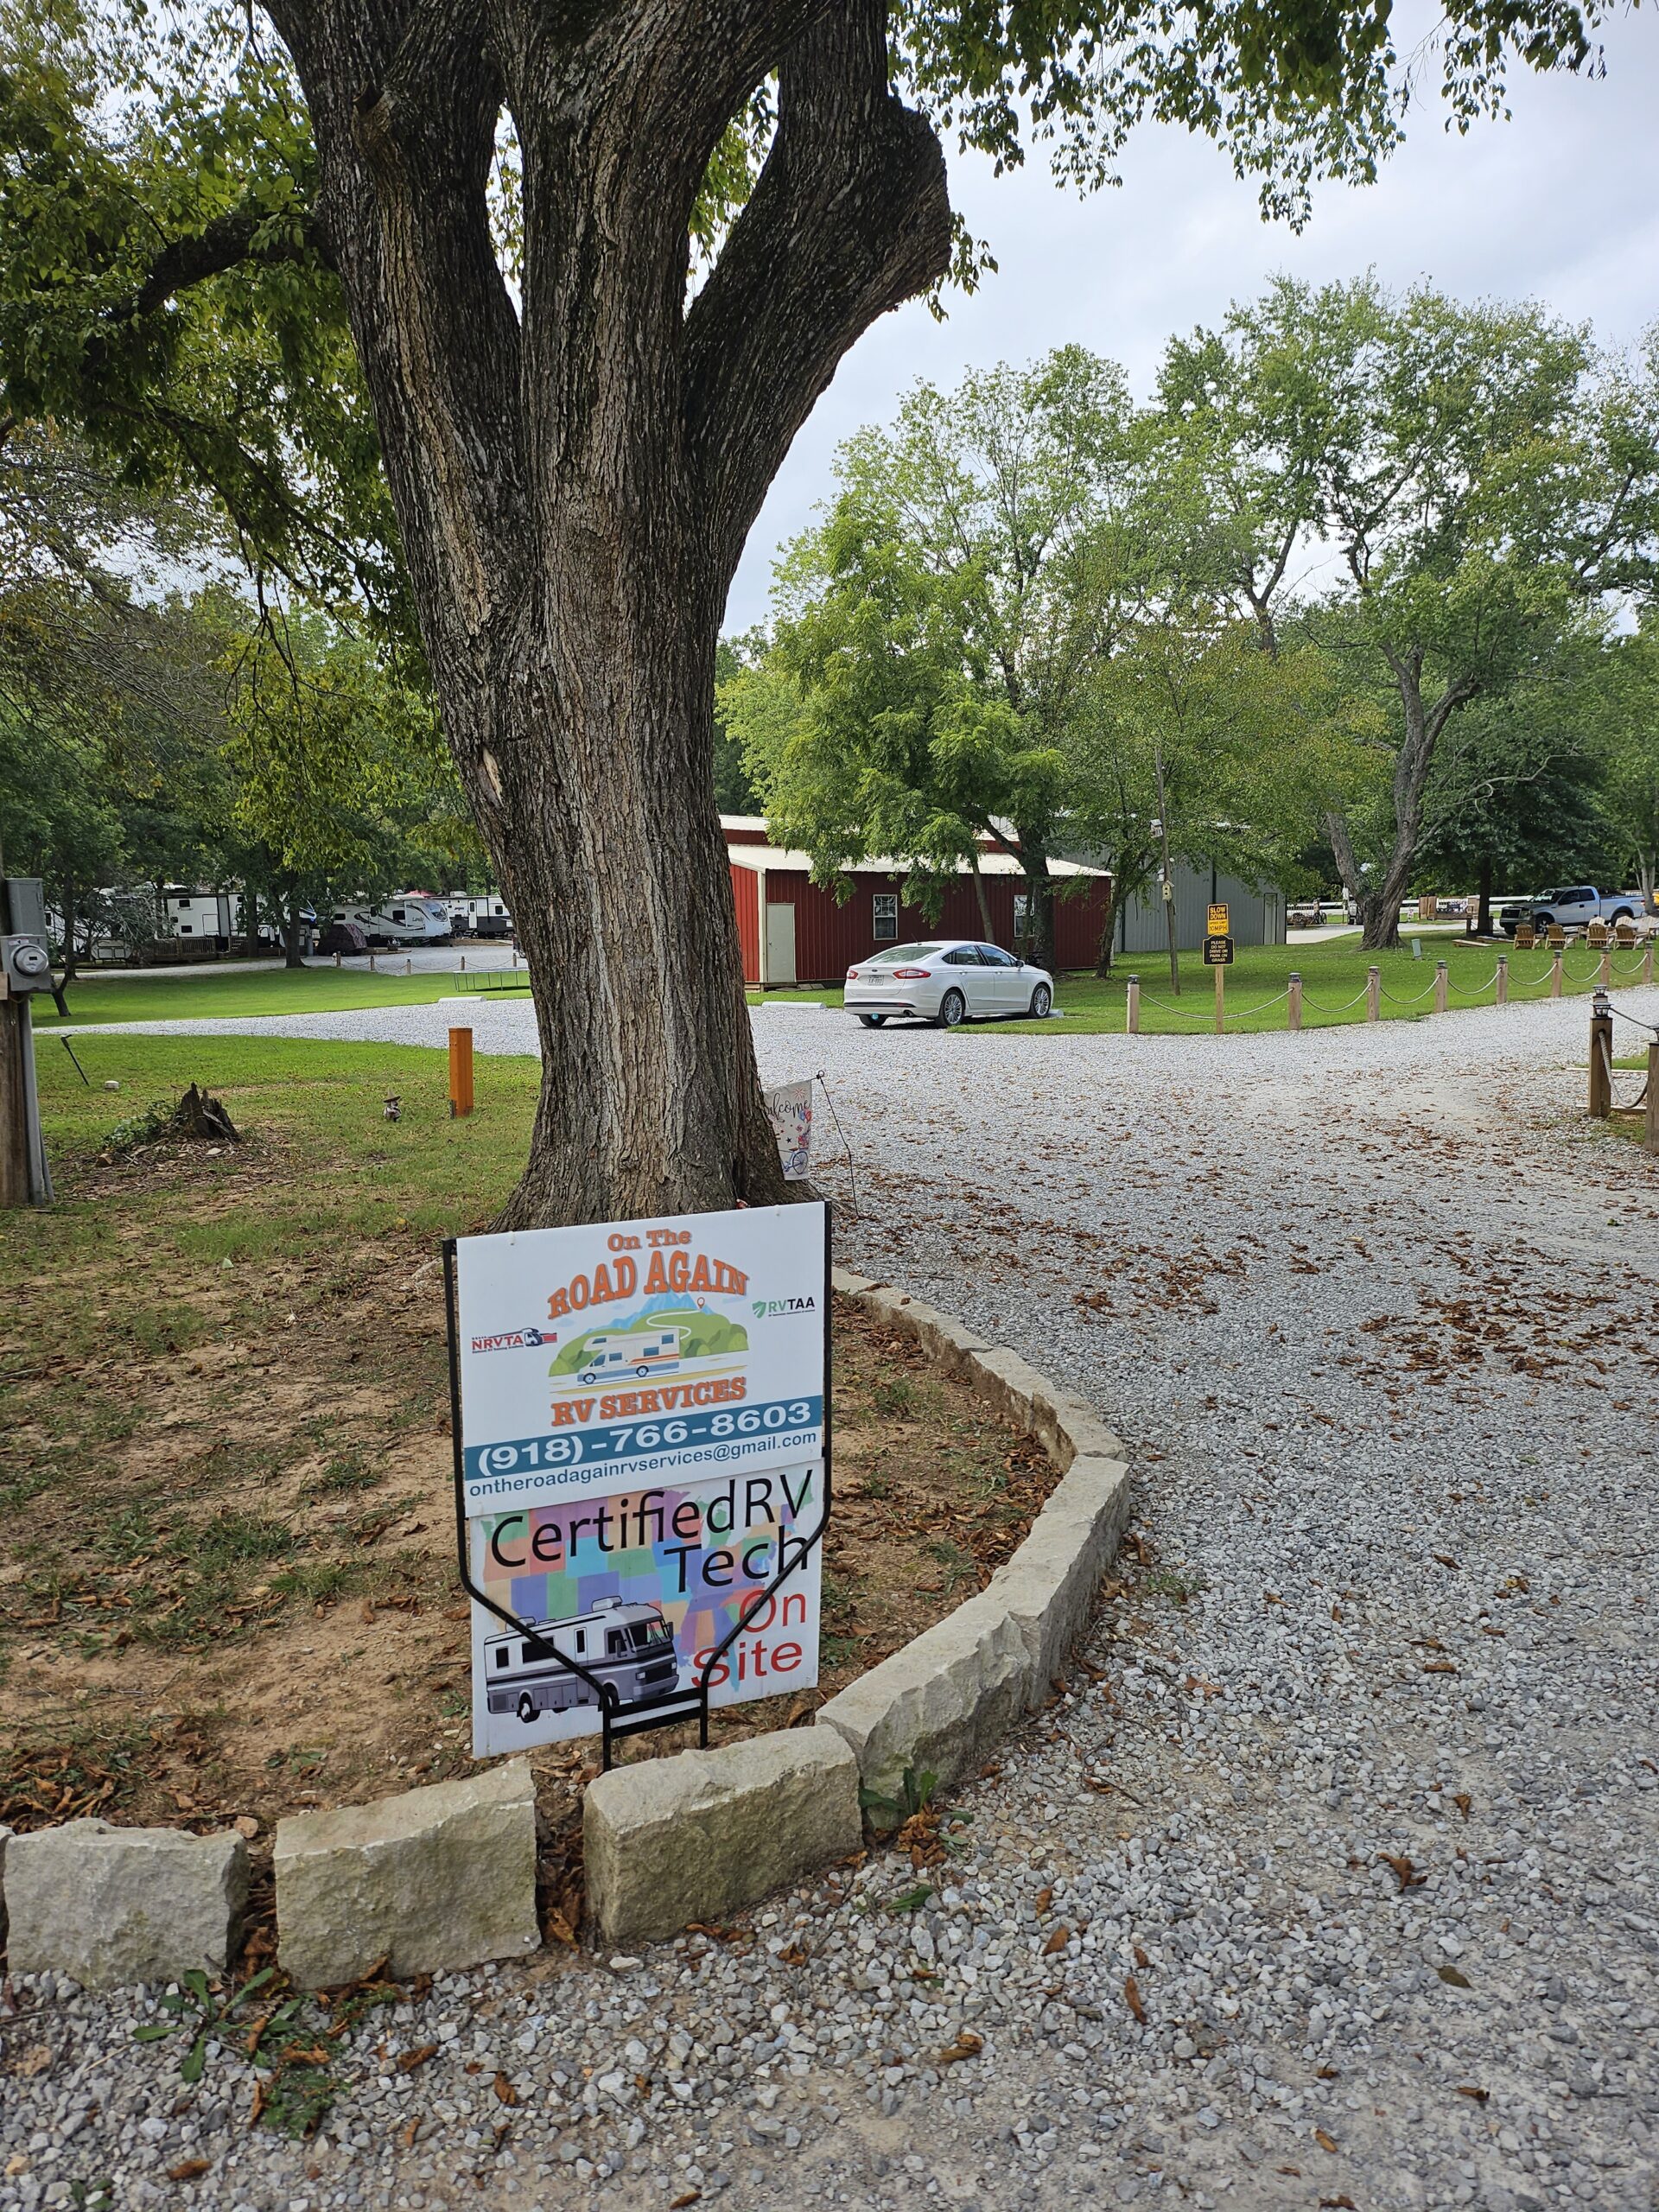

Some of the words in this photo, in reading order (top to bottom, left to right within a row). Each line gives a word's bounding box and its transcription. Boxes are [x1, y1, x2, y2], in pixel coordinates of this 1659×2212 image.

[607, 1233, 641, 1253] On
[645, 1228, 692, 1248] The
[547, 1255, 638, 1320] ROAD
[643, 1249, 750, 1296] AGAIN
[768, 1296, 815, 1313] RVTAA
[472, 1335, 524, 1351] NRVTA
[550, 1398, 595, 1427] RV
[599, 1376, 747, 1420] SERVICES
[469, 1432, 817, 1497] ontheroadagainrvservices@gmail.com
[478, 1402, 811, 1478] (918)-766-8603
[663, 1525, 809, 1593] Tech
[739, 1589, 806, 1633] On
[690, 1639, 803, 1688] Site
